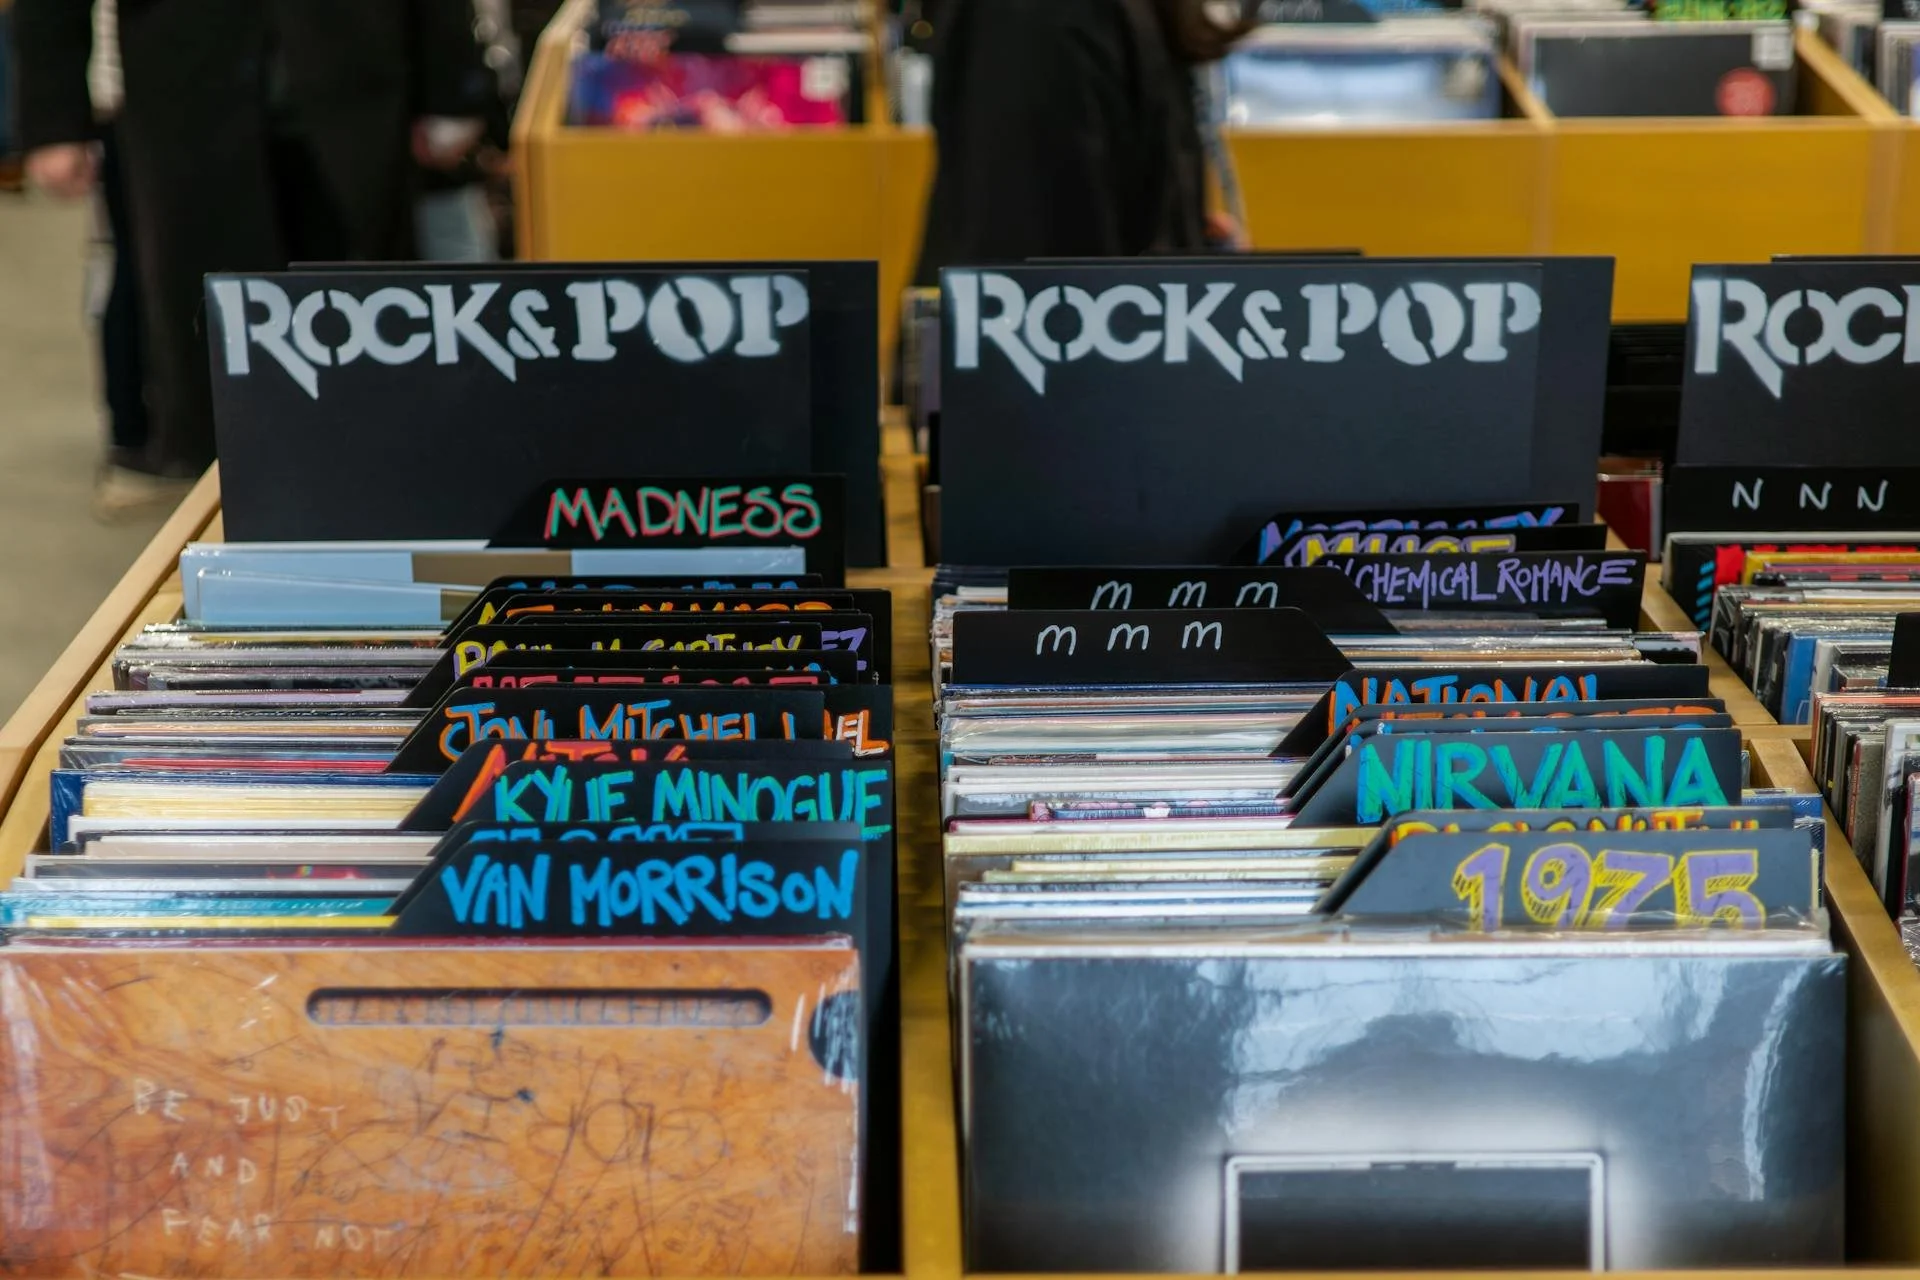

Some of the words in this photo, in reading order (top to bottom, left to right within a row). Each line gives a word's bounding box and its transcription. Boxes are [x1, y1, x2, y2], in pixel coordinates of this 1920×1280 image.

[566, 275, 810, 362] POP
[1299, 280, 1542, 366] POP
[544, 484, 822, 540] MADNESS
[1732, 477, 1763, 510] N
[1800, 482, 1832, 510] N
[1857, 480, 1888, 512] N
[1497, 555, 1637, 603] ROMANCE
[652, 767, 892, 840] MINOGUE
[1357, 735, 1729, 824] NIRVANA
[441, 853, 550, 928] VAN
[569, 849, 859, 927] MORRISON
[1451, 842, 1766, 932] 1975
[132, 1077, 190, 1122] BE
[229, 1092, 346, 1130] JUST
[169, 1151, 257, 1185] AND
[161, 1207, 272, 1248] FEAR
